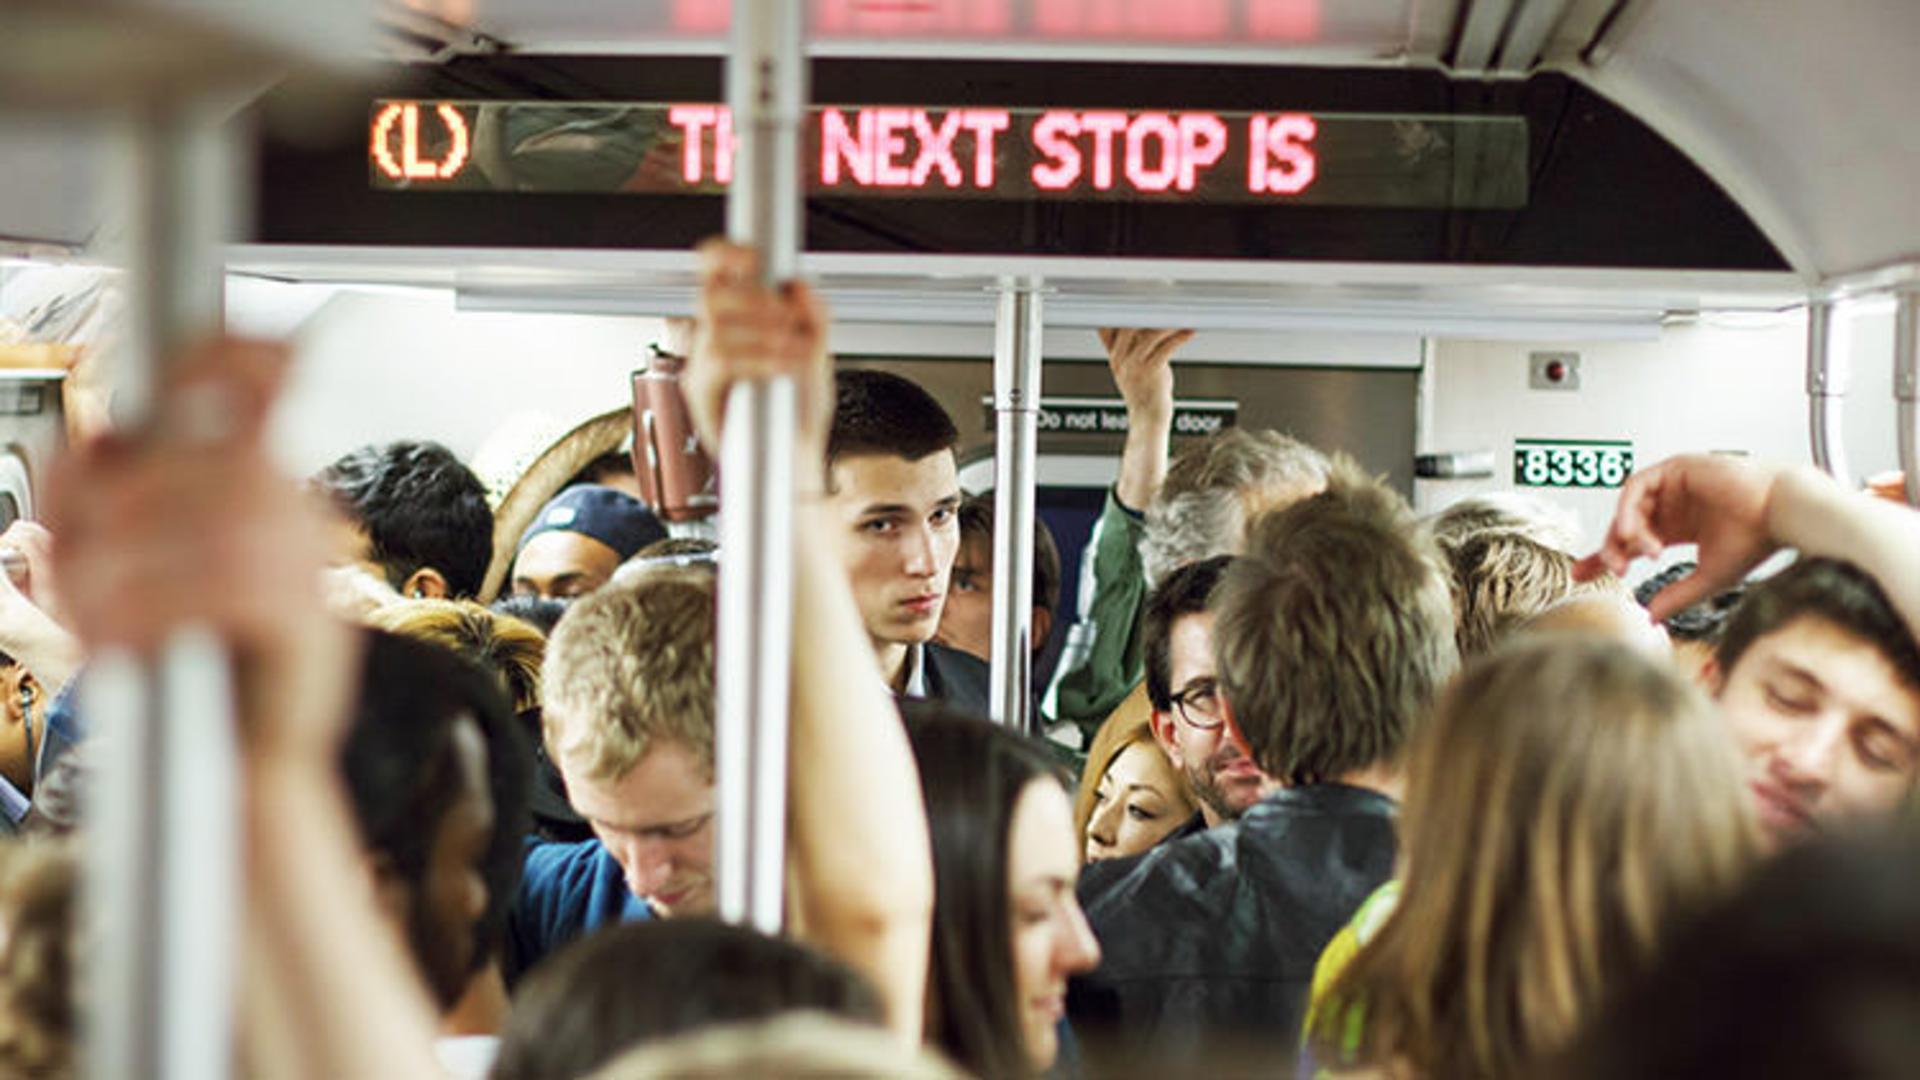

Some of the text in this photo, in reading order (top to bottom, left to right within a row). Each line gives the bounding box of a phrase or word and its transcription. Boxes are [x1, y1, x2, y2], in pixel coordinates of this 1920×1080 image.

[370, 102, 469, 178] (L)
[820, 107, 1009, 186] NEXT
[1031, 110, 1227, 190] STOP
[1248, 113, 1316, 193] IS
[1036, 410, 1222, 432] Do not lea door
[1523, 449, 1625, 487] 8336
